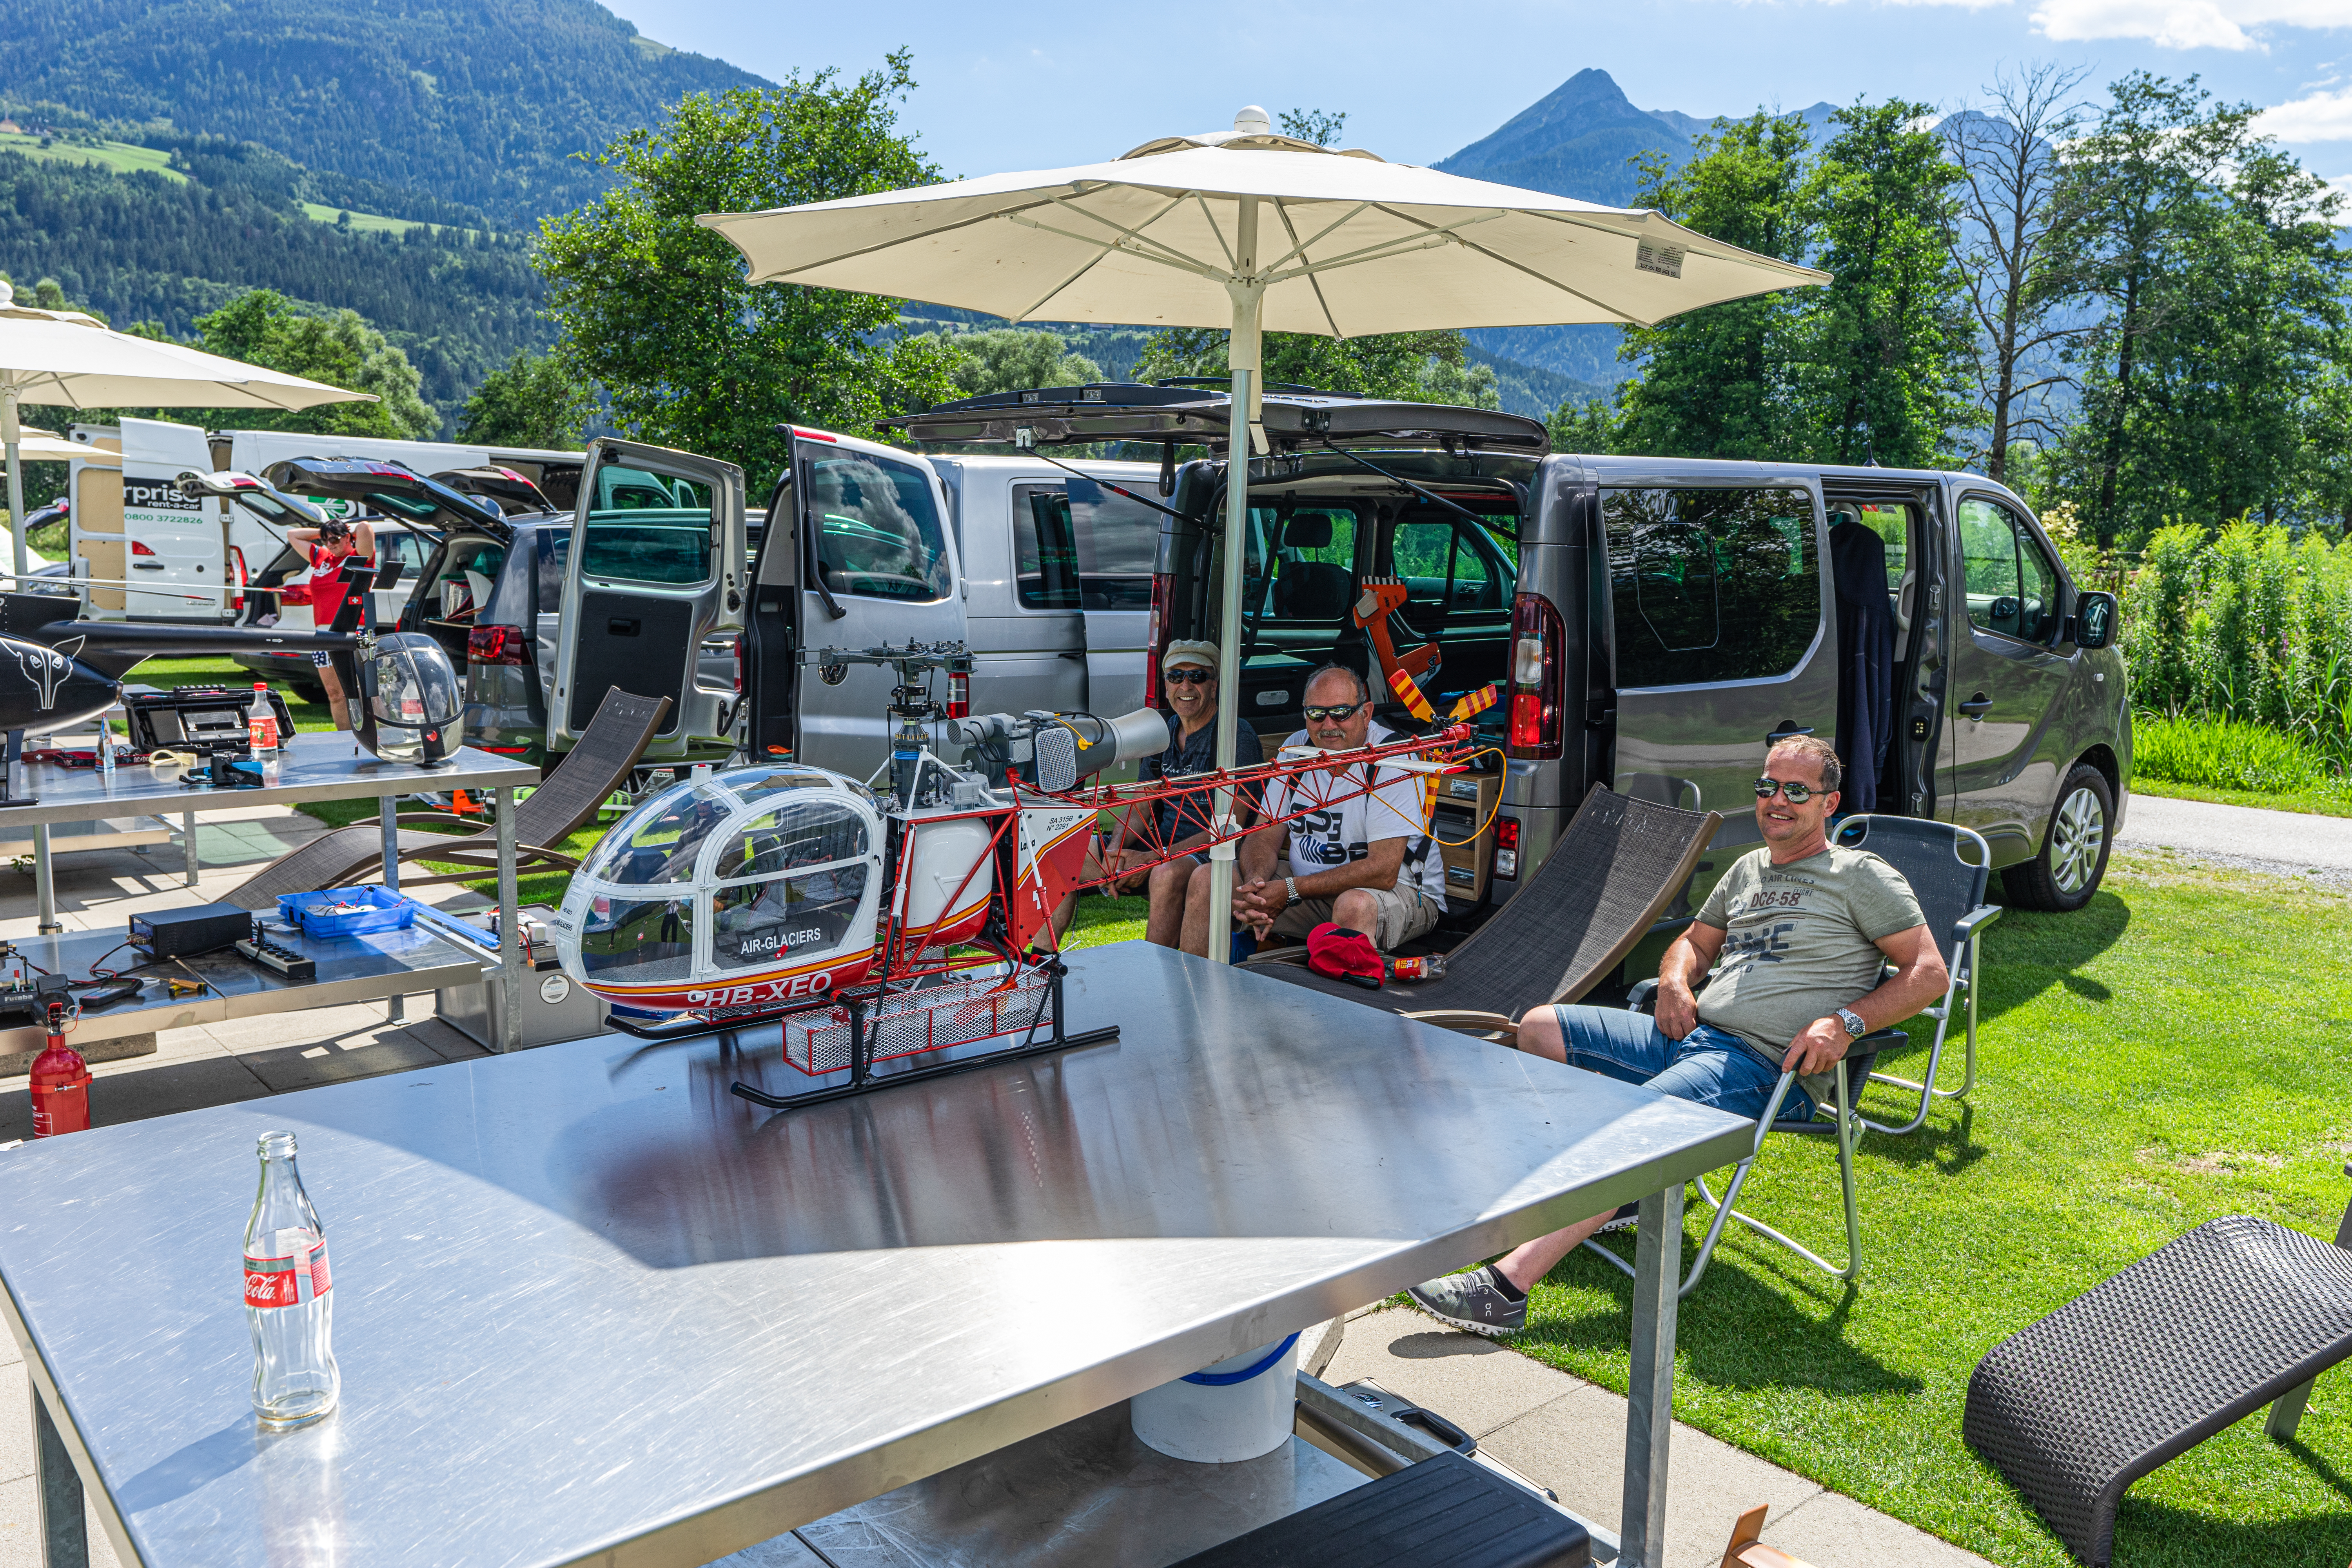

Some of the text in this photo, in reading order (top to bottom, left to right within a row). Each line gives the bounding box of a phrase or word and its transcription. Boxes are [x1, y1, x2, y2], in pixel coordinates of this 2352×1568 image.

[147, 501, 200, 510] rent-a-car
[157, 515, 203, 524] 3722826
[1020, 839, 1035, 851] Laa
[1744, 876, 1766, 888] CARGO
[1750, 891, 1801, 908] DC6-58
[556, 919, 572, 931] AIR-GLACIERS
[741, 928, 821, 954] AIR-GLACIERS
[704, 972, 831, 1007] HB-XEO
